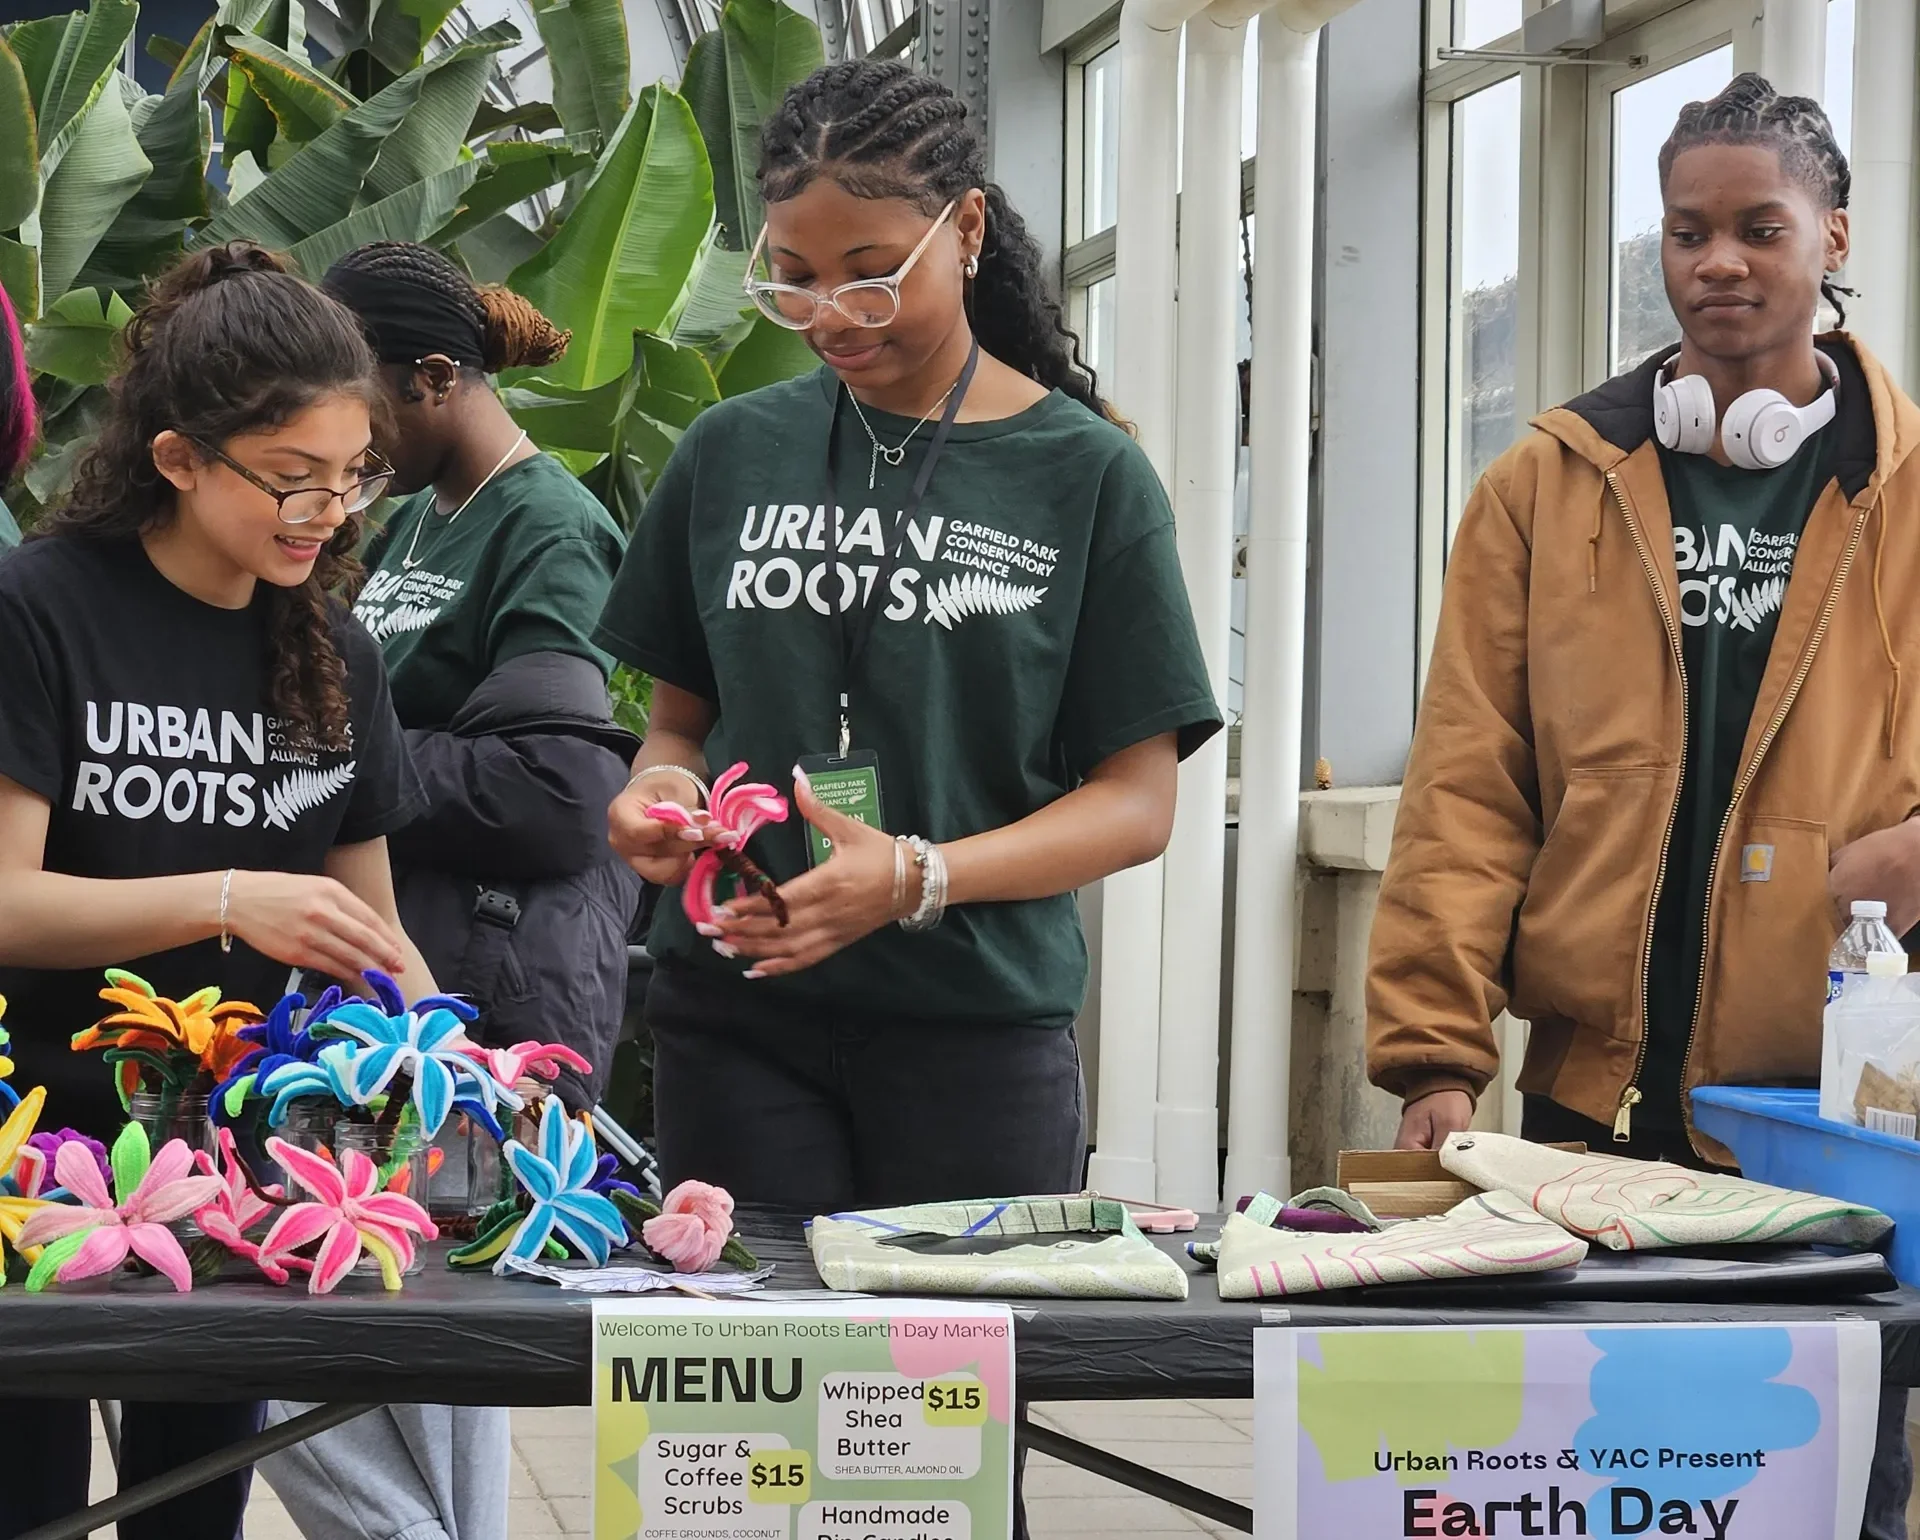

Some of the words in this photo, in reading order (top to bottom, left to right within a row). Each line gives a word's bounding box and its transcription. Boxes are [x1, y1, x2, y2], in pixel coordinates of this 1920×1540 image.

[738, 504, 944, 562] URBAN
[949, 519, 1020, 548] GARFIELD
[1022, 539, 1060, 562] PARK
[940, 548, 1010, 578] ALLIANCE
[945, 534, 1055, 577] CONSERVATORY
[725, 556, 922, 622] ROOTS
[86, 700, 265, 765] URBAN
[71, 761, 256, 827] ROOTS
[813, 782, 847, 791] GARFIELD
[848, 779, 867, 788] PARK
[599, 1322, 688, 1338] Welcome
[692, 1322, 714, 1337] To
[719, 1322, 779, 1338] Urban
[784, 1322, 840, 1338] Roots
[845, 1323, 899, 1338] Earth
[904, 1323, 939, 1340] Day
[611, 1357, 803, 1403] MENU
[823, 1381, 925, 1405] Whipped
[928, 1385, 981, 1412] $15
[845, 1409, 902, 1428] Shea
[657, 1439, 728, 1463] Sugar
[735, 1439, 752, 1458] &
[837, 1438, 911, 1456] Butter
[834, 1465, 861, 1475] SHEA
[863, 1465, 904, 1476] BUTTER,
[905, 1465, 947, 1474] ALMOND
[949, 1465, 964, 1474] OIL
[1374, 1450, 1458, 1472] Urban
[1467, 1450, 1547, 1471] Roots
[1556, 1449, 1579, 1471] &
[1589, 1448, 1650, 1469] YAC
[1658, 1448, 1766, 1469] Present
[664, 1467, 743, 1487] Coffee
[751, 1462, 804, 1488] $15
[664, 1496, 743, 1515] Scrubs
[822, 1505, 950, 1525] Handmade
[1403, 1485, 1587, 1537] Earth
[1610, 1487, 1740, 1540] Day
[645, 1529, 678, 1538] COFFE
[679, 1529, 731, 1539] GROUNDS,
[733, 1529, 782, 1538] COCONUT
